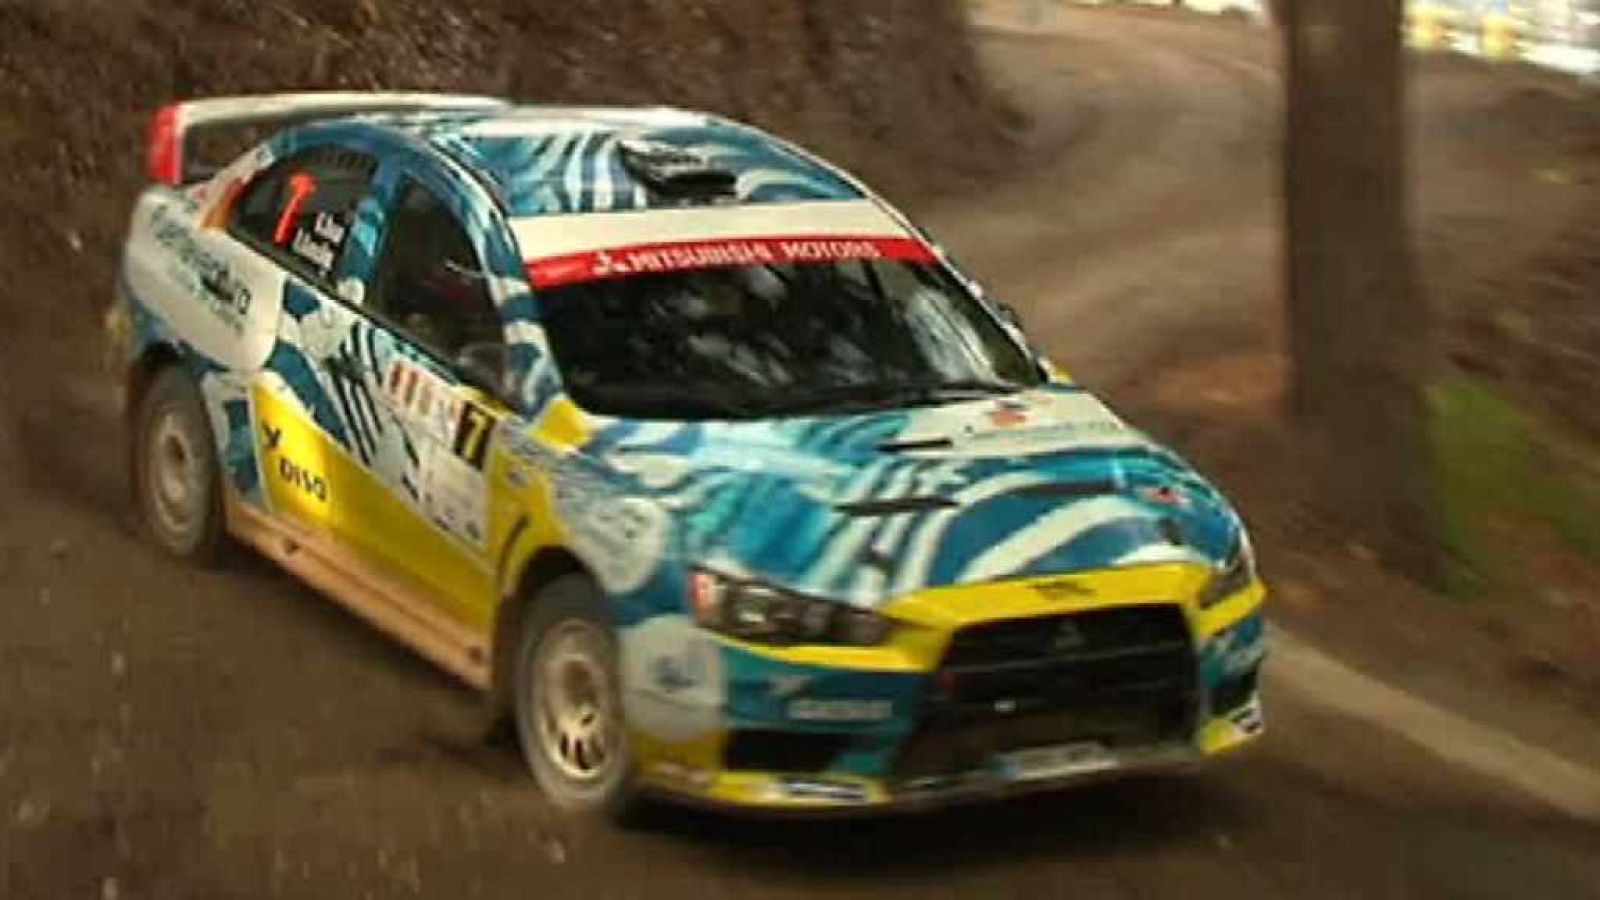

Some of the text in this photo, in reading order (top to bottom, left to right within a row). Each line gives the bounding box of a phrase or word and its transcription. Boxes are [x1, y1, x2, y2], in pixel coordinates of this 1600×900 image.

[274, 172, 317, 244] 7
[627, 240, 881, 273] MITSUBISHI MOTORS
[462, 409, 488, 461] 7
